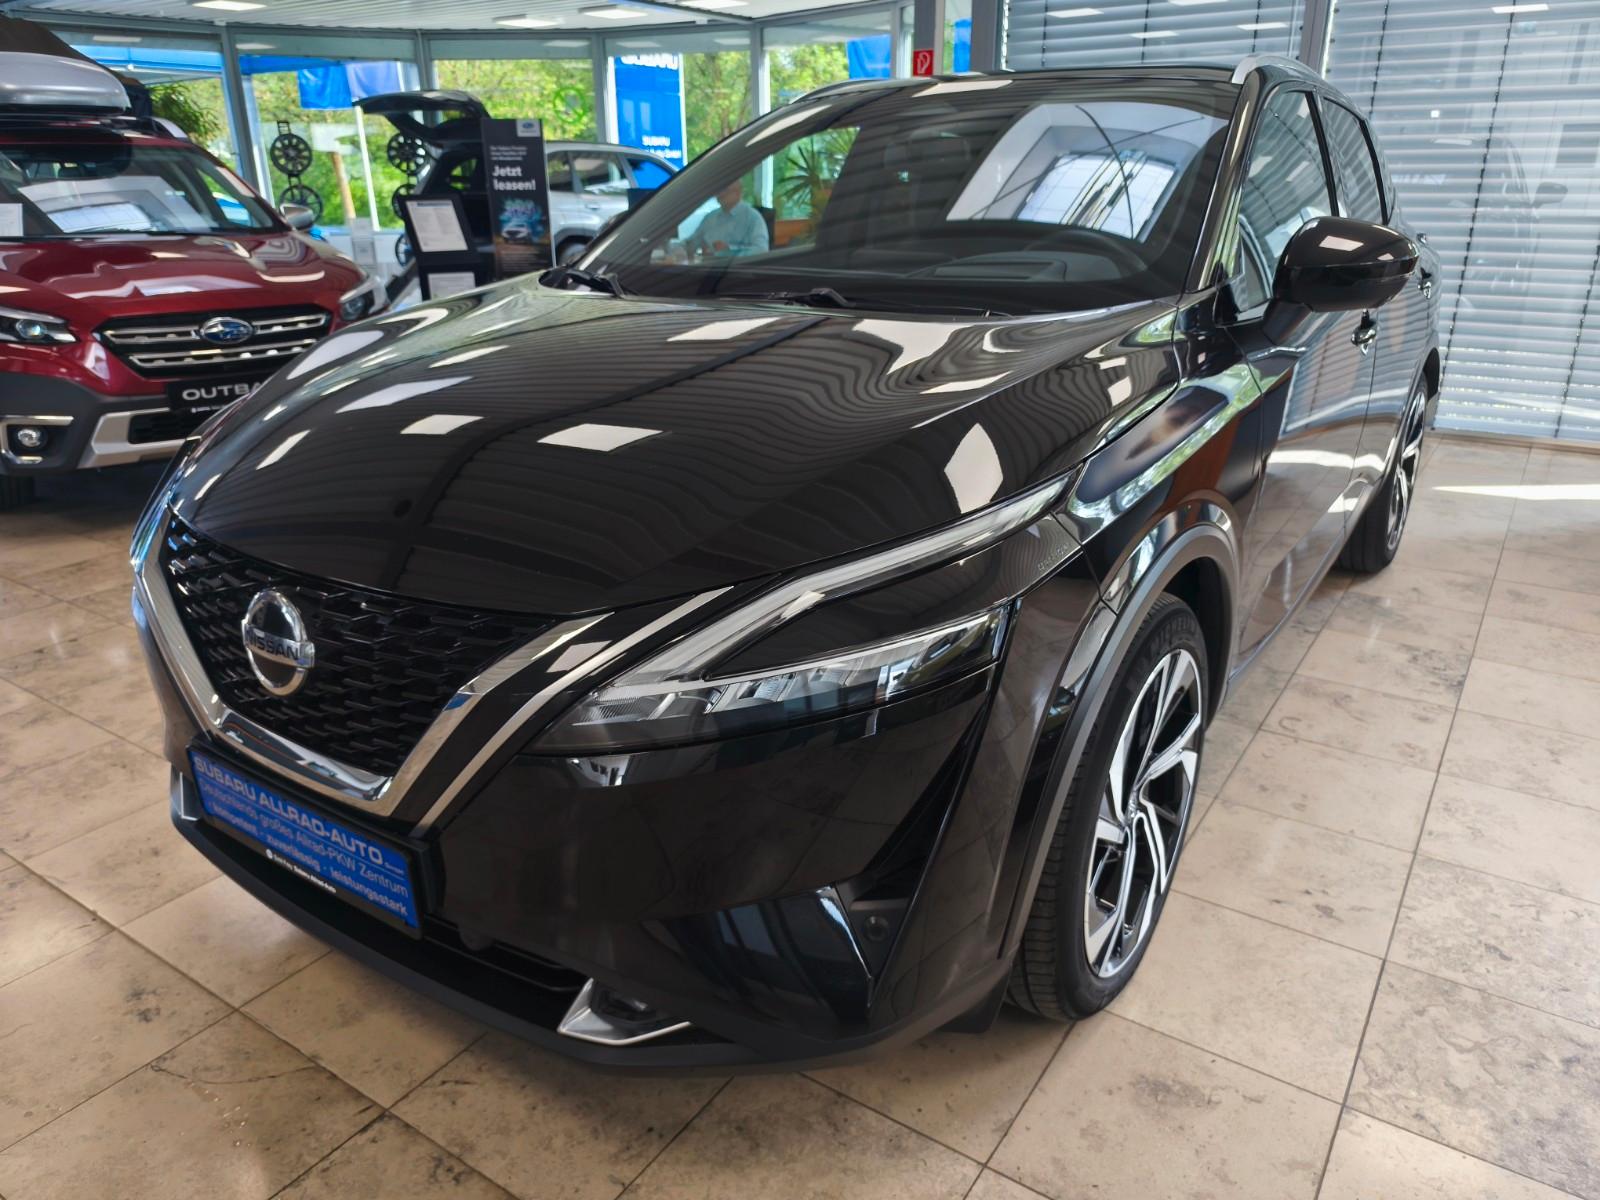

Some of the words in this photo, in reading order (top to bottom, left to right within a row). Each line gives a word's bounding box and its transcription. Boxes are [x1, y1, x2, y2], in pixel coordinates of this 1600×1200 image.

[492, 165, 522, 177] Jetzt
[493, 179, 537, 191] leasen!
[245, 629, 299, 660] NISSAN
[193, 756, 257, 800] SUBARU
[258, 793, 384, 866] ALLRAD-AUTO
[329, 866, 408, 916] leistungsstark
[358, 863, 408, 898] Zentrum
